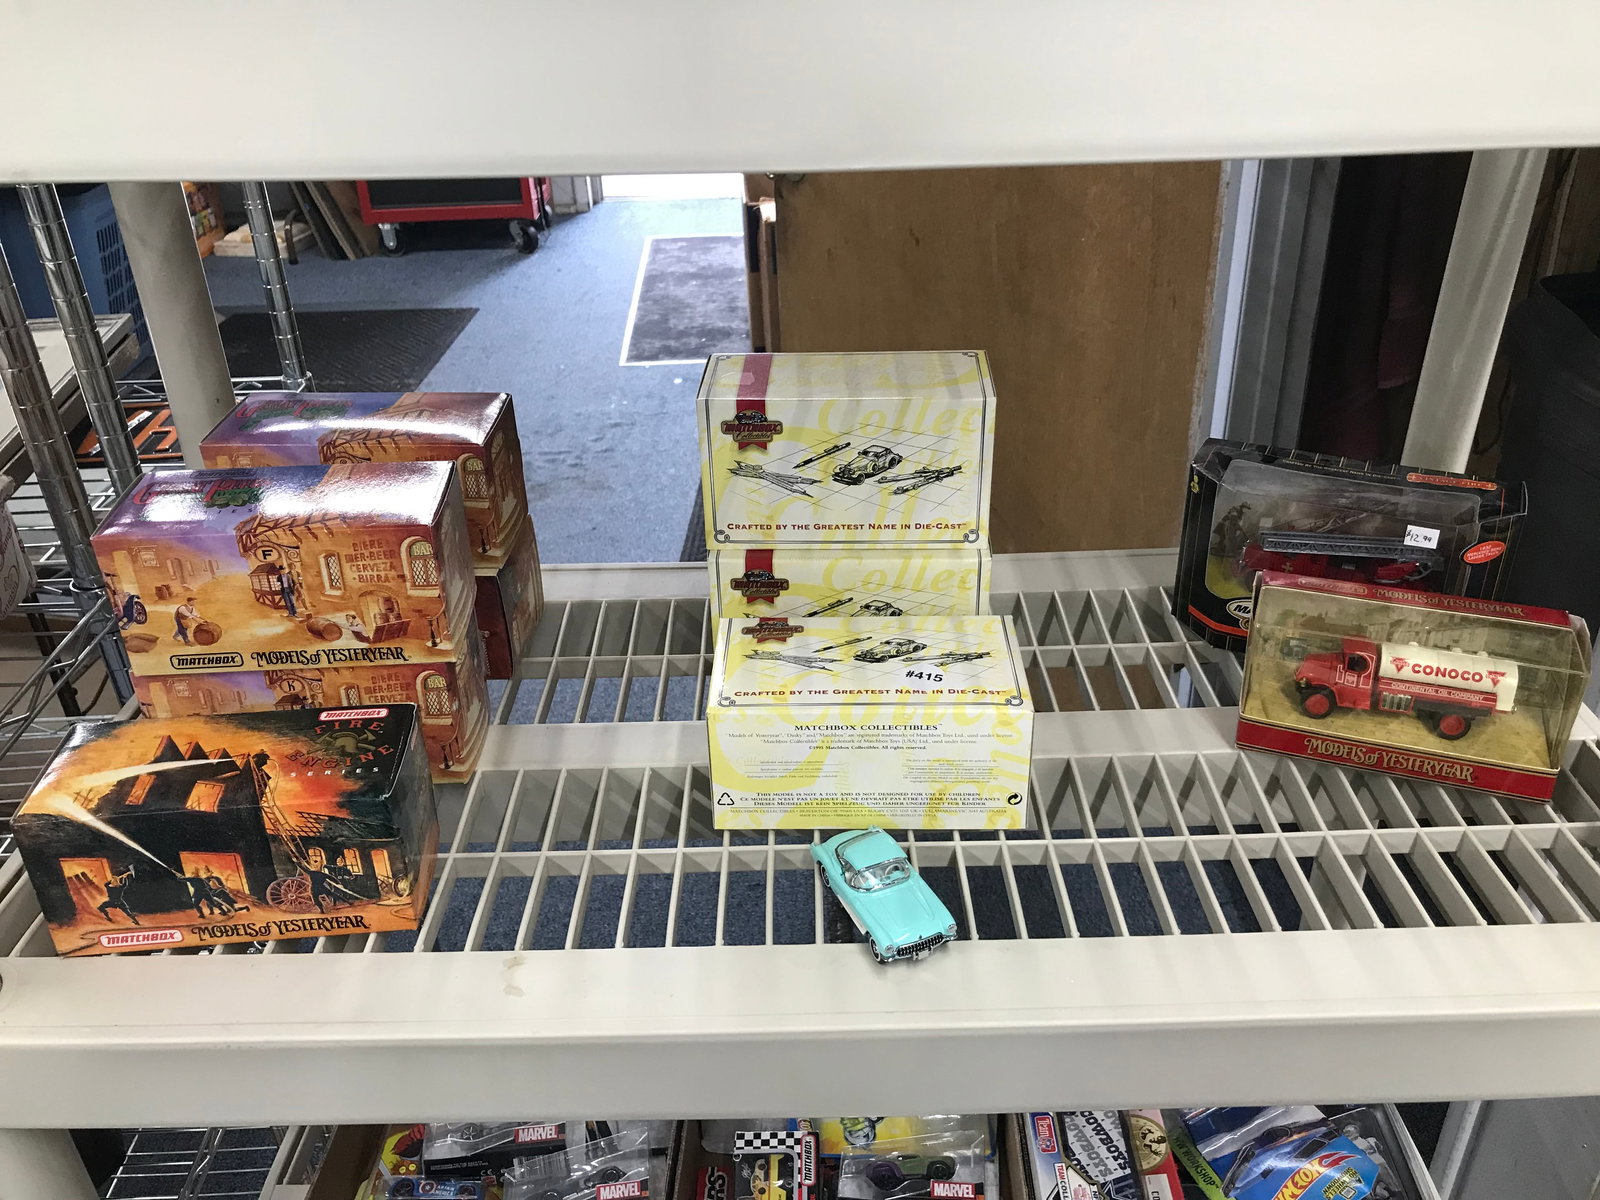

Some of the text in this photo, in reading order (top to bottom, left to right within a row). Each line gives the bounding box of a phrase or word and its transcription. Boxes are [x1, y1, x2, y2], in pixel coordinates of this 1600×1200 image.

[467, 461, 484, 471] BAR
[727, 523, 962, 531] CRAFTED BY THE GREATEST NAME IN DIE-CAST
[352, 541, 383, 551] BIERE
[413, 543, 434, 555] BAR
[261, 549, 273, 560] F
[350, 562, 397, 573] CERVEZA
[358, 573, 392, 583] BIRRA
[1373, 588, 1525, 616] MODELS of YESTERYEAR
[176, 646, 410, 667] MATCHBOX MODELS of YESTERYEAR
[905, 670, 943, 682] #415
[1411, 663, 1484, 682] CONOCO
[287, 680, 295, 692] K
[427, 677, 447, 688] BAR
[324, 710, 384, 718] MATCHBOX
[314, 720, 385, 735] FIRE
[286, 744, 395, 769] ENGINE
[1304, 737, 1475, 783] MODELS of YESTERYEAR
[290, 767, 379, 777] SERIES
[106, 915, 370, 945] MATCHBOX MODELS of YESTERYEAR
[518, 1125, 558, 1141] MARVEL
[1080, 1110, 1129, 1171] COWBOYS
[803, 1139, 812, 1183] MATCHBOX
[1183, 1147, 1216, 1186] WORKSHOP
[600, 1183, 640, 1200] MARVEL
[934, 1183, 974, 1198] MARVEL
